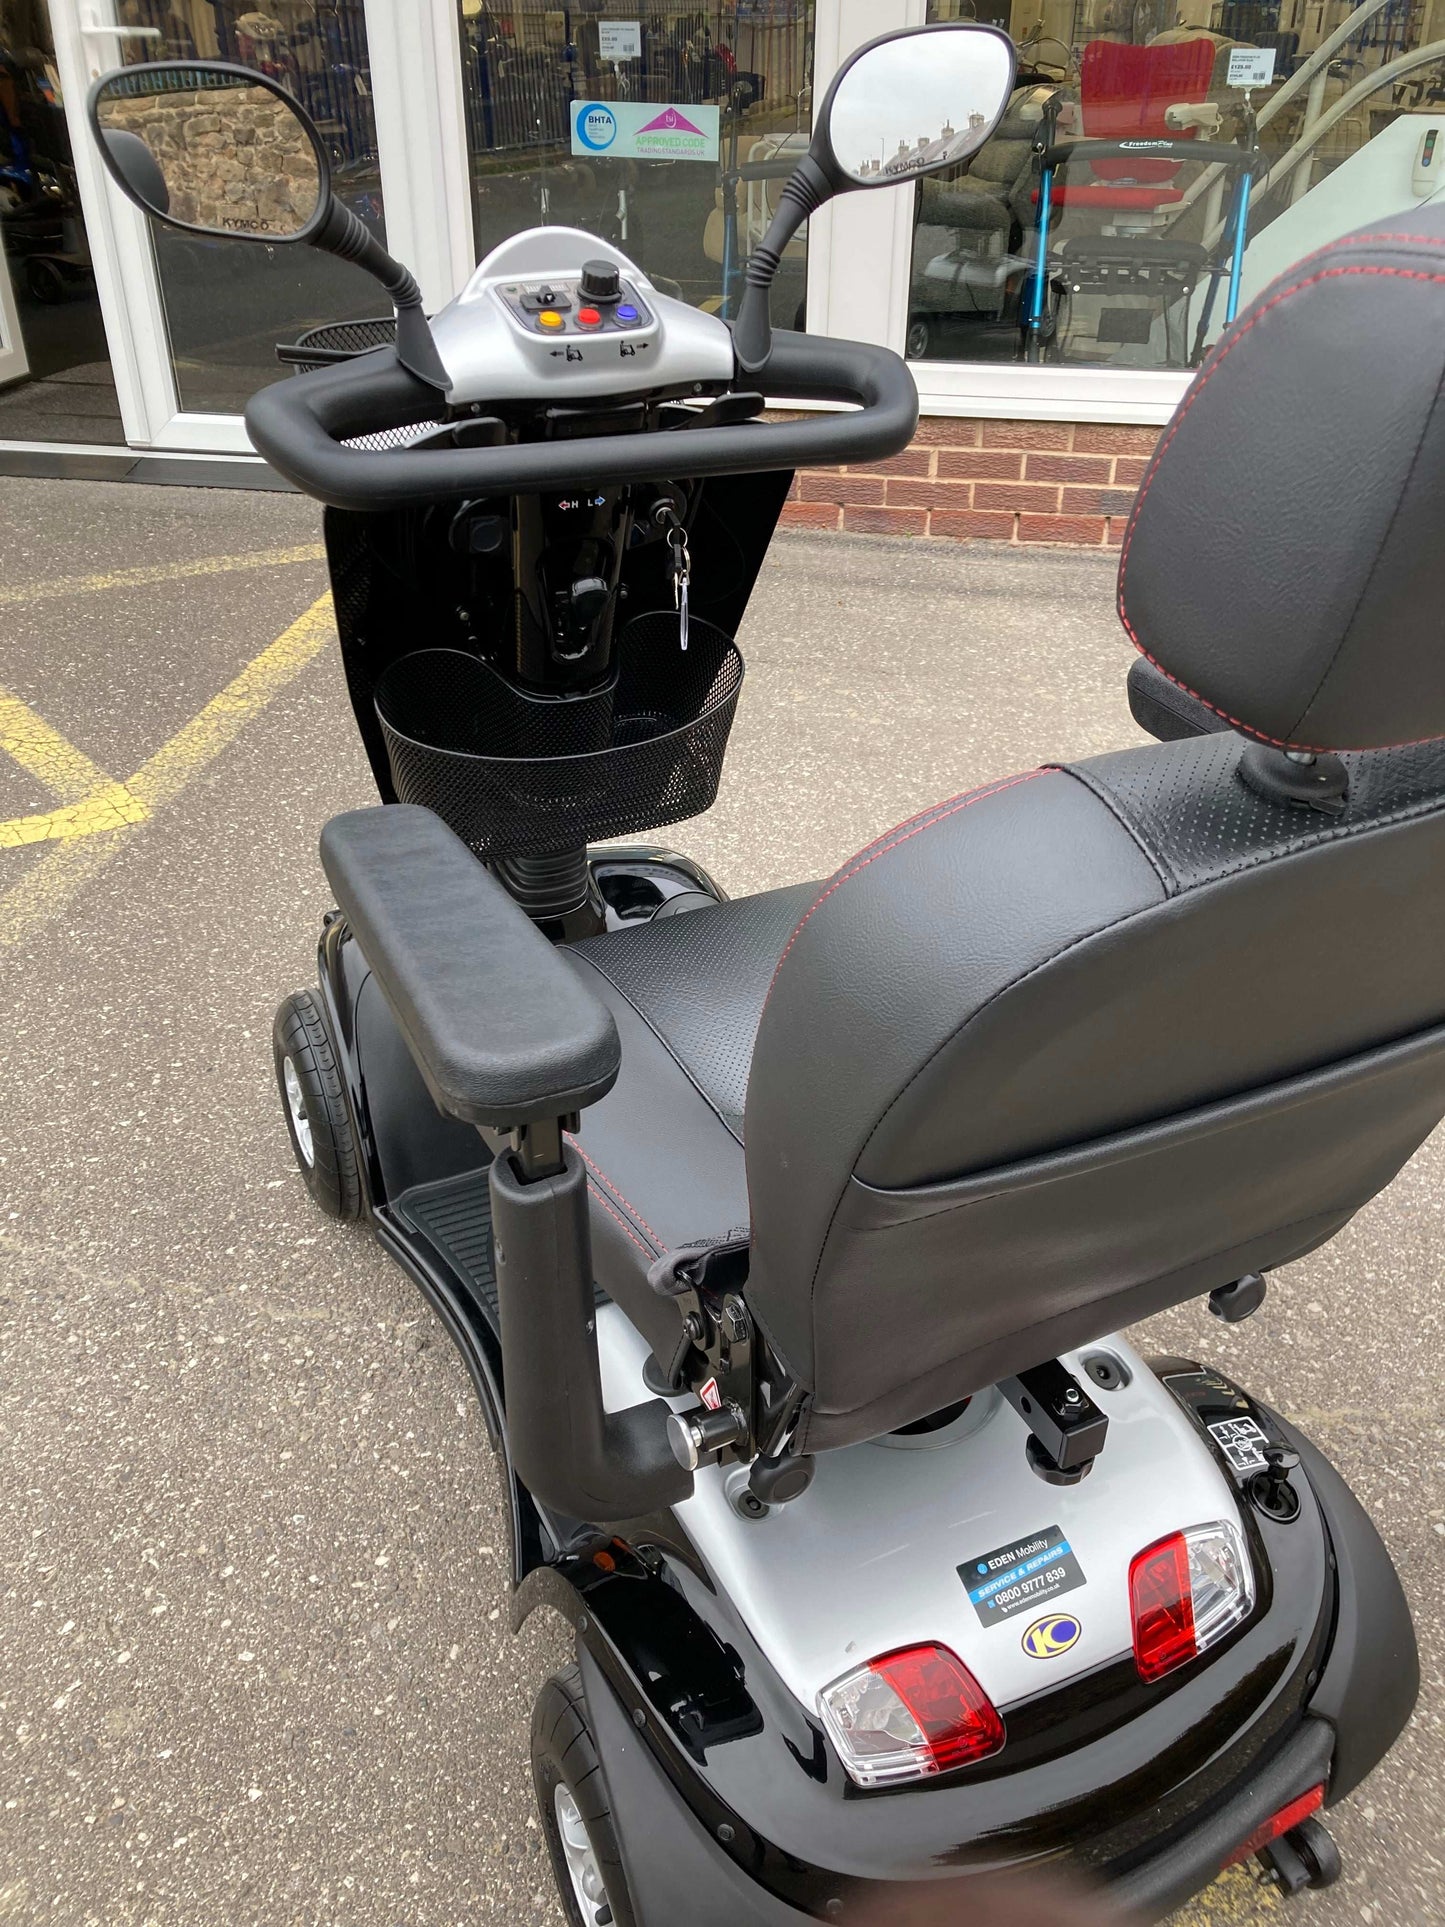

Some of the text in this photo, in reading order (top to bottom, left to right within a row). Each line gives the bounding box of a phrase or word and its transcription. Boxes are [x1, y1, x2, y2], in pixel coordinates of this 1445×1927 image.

[588, 115, 612, 125] BHTA
[636, 136, 705, 148] APPROVED CODE
[222, 217, 269, 231] KYMCO
[571, 498, 593, 509] H L
[987, 1539, 1048, 1570] EDEN Mobility
[977, 1546, 1064, 1598] SERVICE & REPAIRS
[994, 1566, 1066, 1605] 0800 9777 839
[1006, 1583, 1061, 1610] www.edenmobility.co.uk
